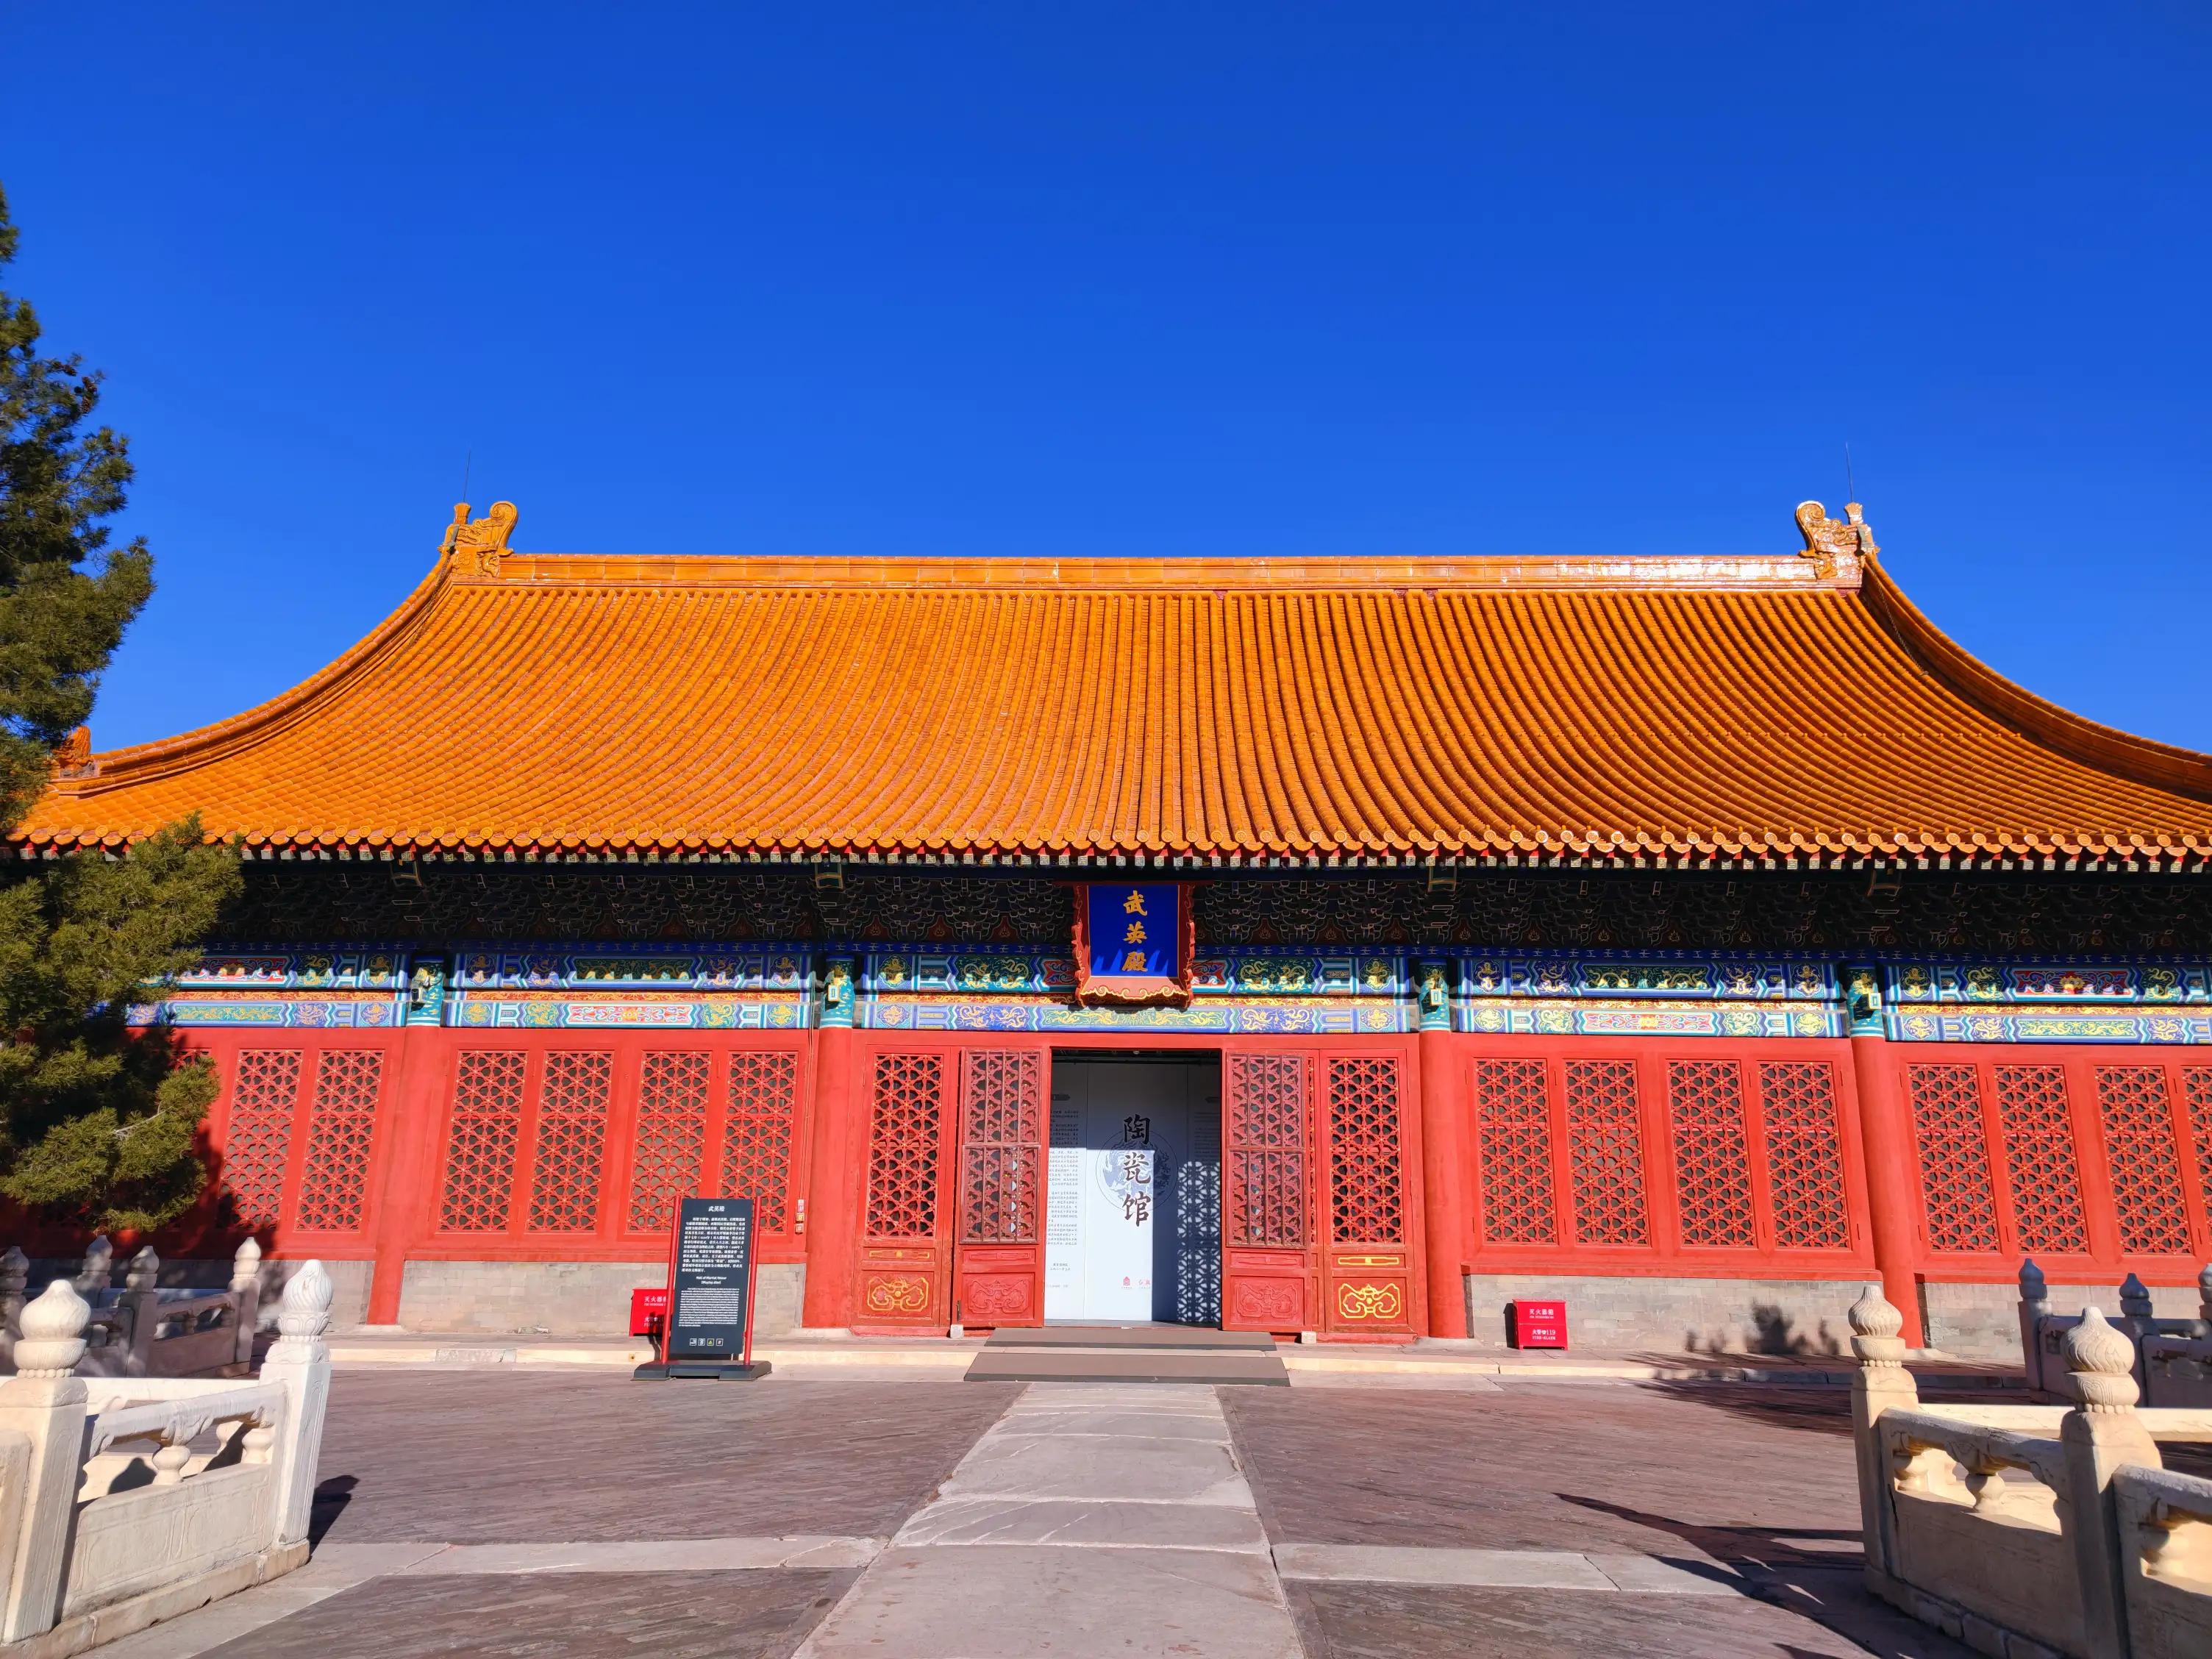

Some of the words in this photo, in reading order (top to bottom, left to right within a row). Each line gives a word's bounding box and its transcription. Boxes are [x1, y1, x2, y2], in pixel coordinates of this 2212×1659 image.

[1122, 889, 1148, 972] 武英殿
[1121, 1113, 1152, 1227] 陶瓷馆
